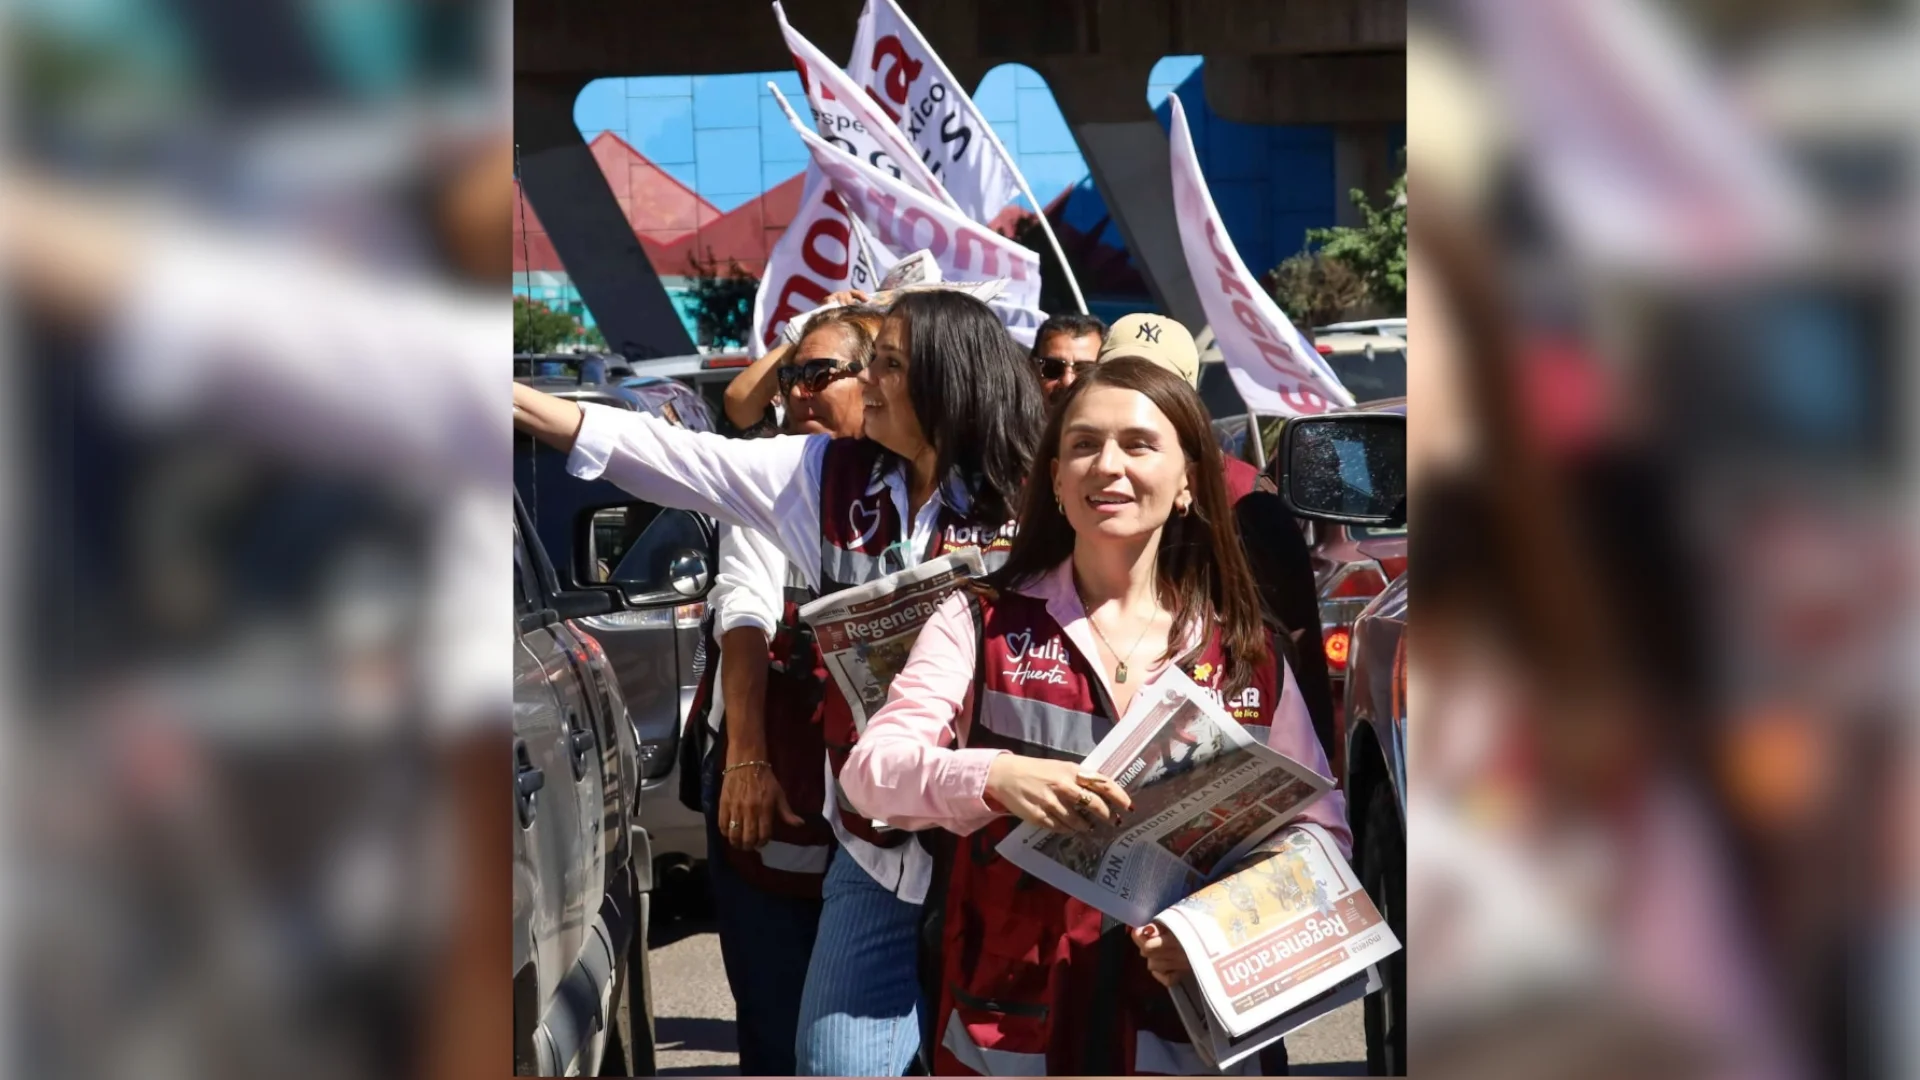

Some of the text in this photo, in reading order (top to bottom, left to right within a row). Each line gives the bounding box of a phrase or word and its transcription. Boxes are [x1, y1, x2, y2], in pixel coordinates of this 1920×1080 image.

[844, 591, 948, 640] Regeneraci
[1002, 660, 1069, 686] Huerta
[1116, 757, 1147, 788] RITARON
[1102, 853, 1126, 889] PAN.
[1117, 809, 1179, 851] TRAIDOR
[1181, 801, 1192, 811] A
[1192, 788, 1212, 804] LA
[1213, 758, 1262, 789] PATRIA
[1221, 912, 1350, 987] Regeneración
[1351, 934, 1383, 955] morena
